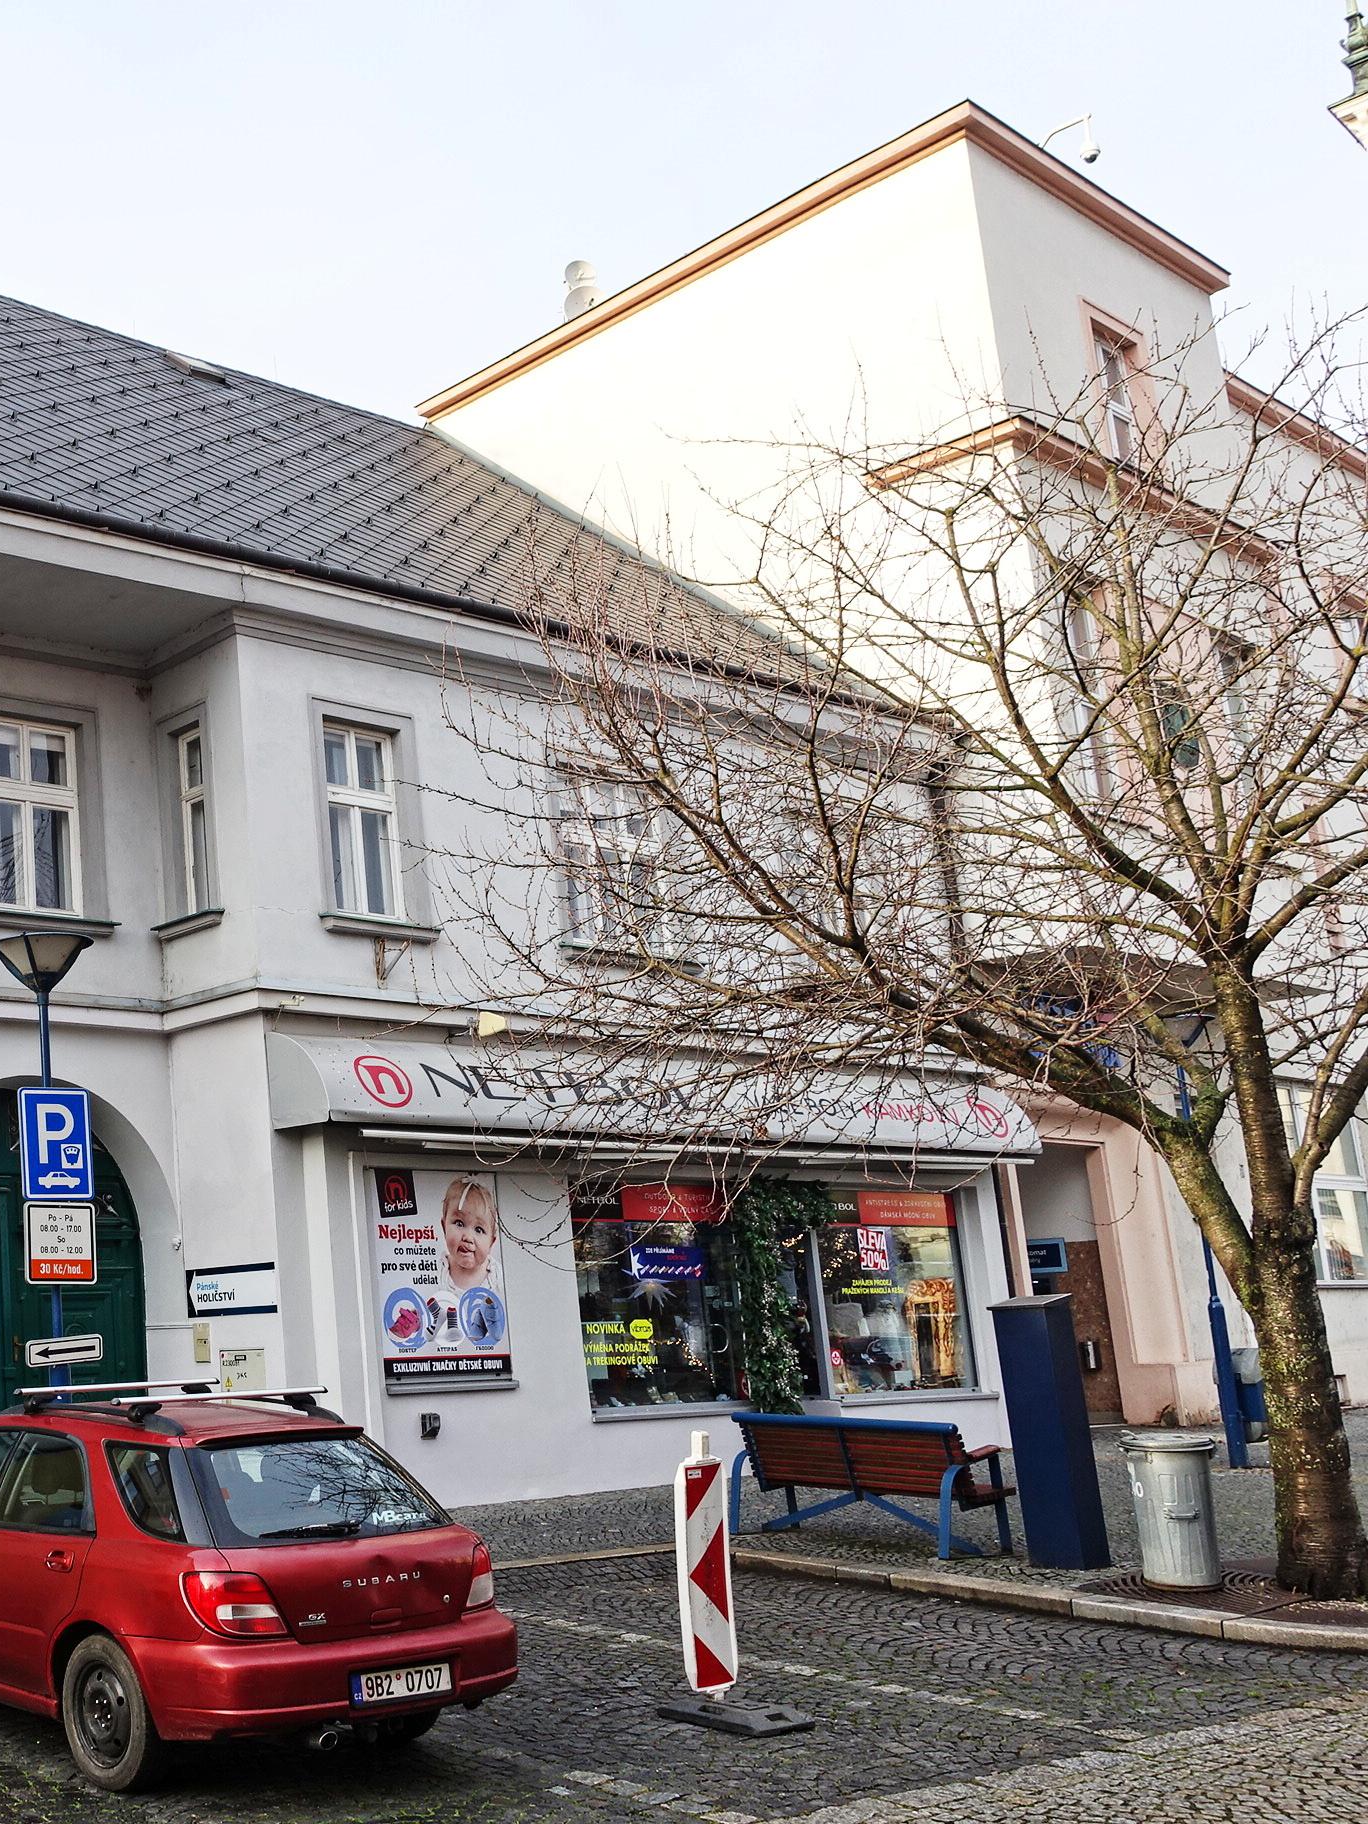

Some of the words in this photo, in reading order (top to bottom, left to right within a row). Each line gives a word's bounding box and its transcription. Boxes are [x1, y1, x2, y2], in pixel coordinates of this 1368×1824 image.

[36, 1104, 74, 1164] P
[384, 1204, 396, 1213] for
[397, 1198, 413, 1210] kids
[48, 1214, 56, 1222] Po
[65, 1214, 73, 1222] Pá
[57, 1235, 66, 1243] So
[378, 1224, 438, 1243] Nejlepší,
[858, 1229, 886, 1251] SLEVA
[40, 1246, 58, 1254] 08.00
[66, 1246, 83, 1254] 12.00
[394, 1247, 404, 1255] co
[406, 1245, 436, 1256] můžete
[381, 1262, 397, 1274] pro
[399, 1260, 416, 1271] své
[418, 1259, 438, 1271] děti
[860, 1250, 889, 1270] 50%
[40, 1263, 51, 1274] 30
[53, 1263, 84, 1275] Kč/hod.
[196, 1281, 219, 1291] Pánské
[413, 1274, 438, 1285] udělat
[197, 1289, 235, 1303] HOLIČSTVÍ
[586, 1324, 626, 1334] NOVINKA
[584, 1341, 613, 1353] VÝMĚNA
[615, 1341, 650, 1353] PODRÁŽEK
[393, 1361, 431, 1373] EXKLUZIVNÍ
[432, 1360, 457, 1372] ZNAČKY
[458, 1358, 482, 1370] DĚTSKÉ
[484, 1360, 503, 1369] OBUVI
[592, 1355, 636, 1366] TREKINGOVÉ
[637, 1356, 658, 1365] OBUVI
[342, 1570, 420, 1588] SUBARU
[365, 1674, 394, 1698] 9B2
[405, 1667, 442, 1692] 0707
